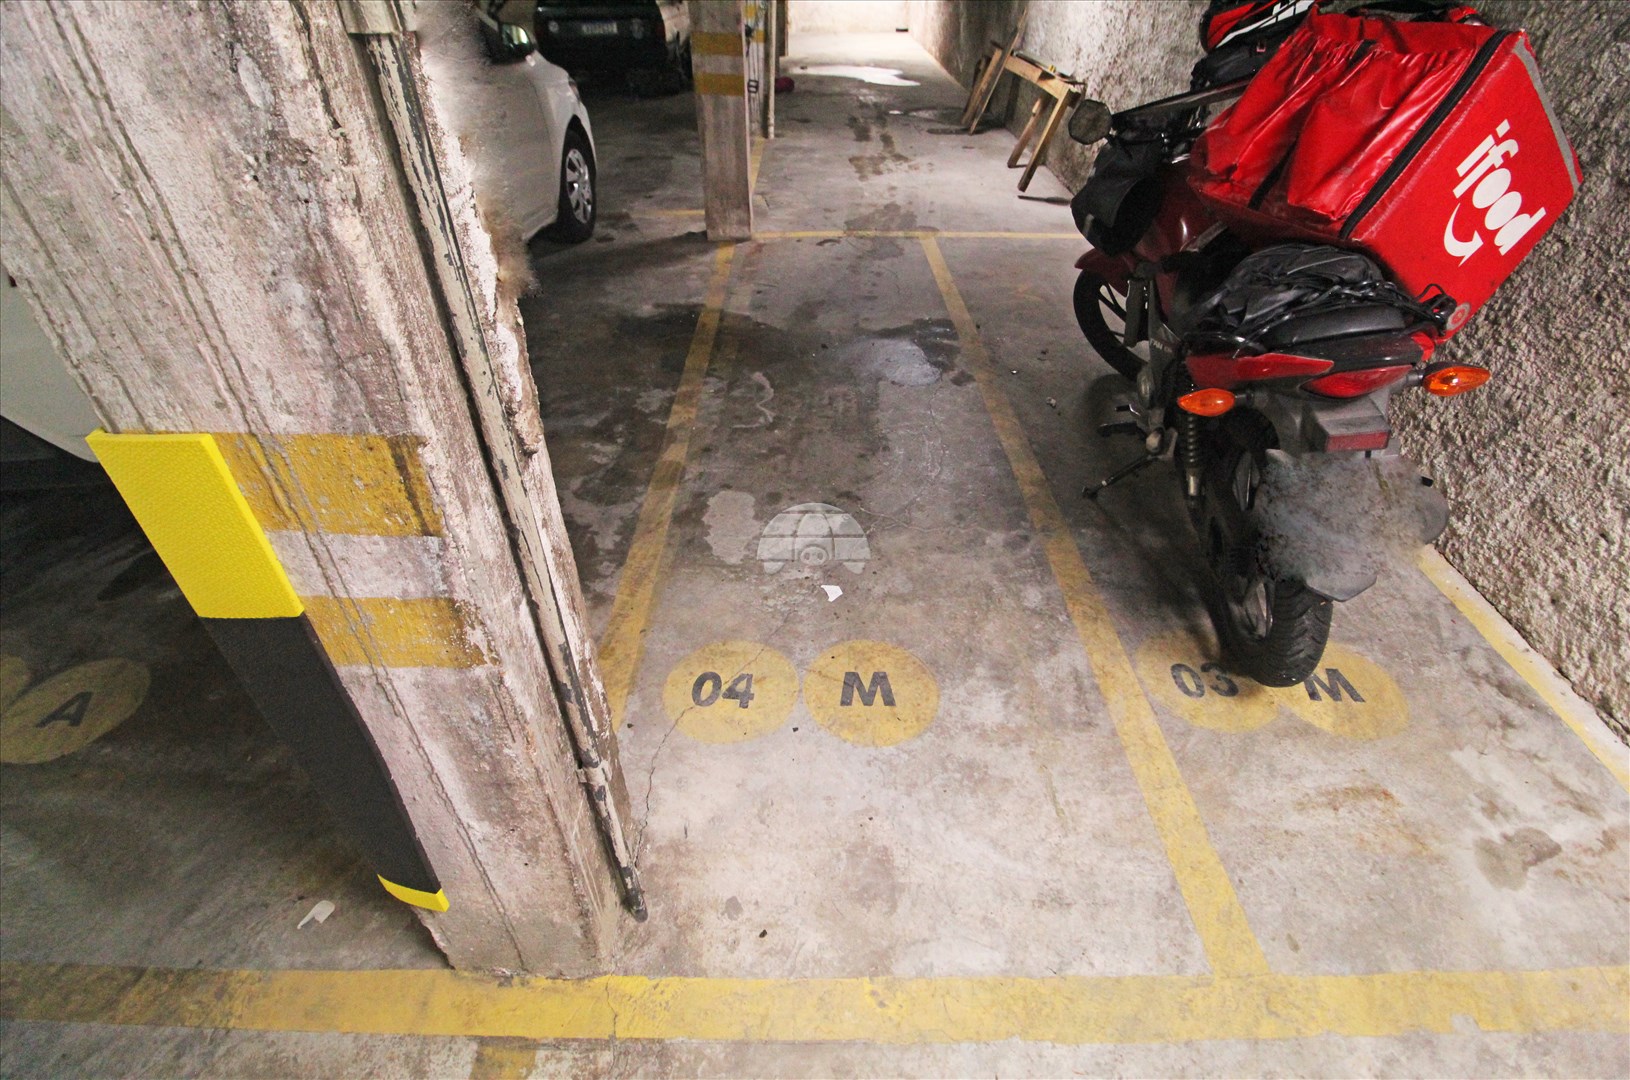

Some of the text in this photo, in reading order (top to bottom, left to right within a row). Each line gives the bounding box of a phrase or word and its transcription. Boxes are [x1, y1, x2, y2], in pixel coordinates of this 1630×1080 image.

[691, 671, 897, 709] 04 M
[1170, 662, 1366, 703] 03 M
[35, 691, 93, 728] A
